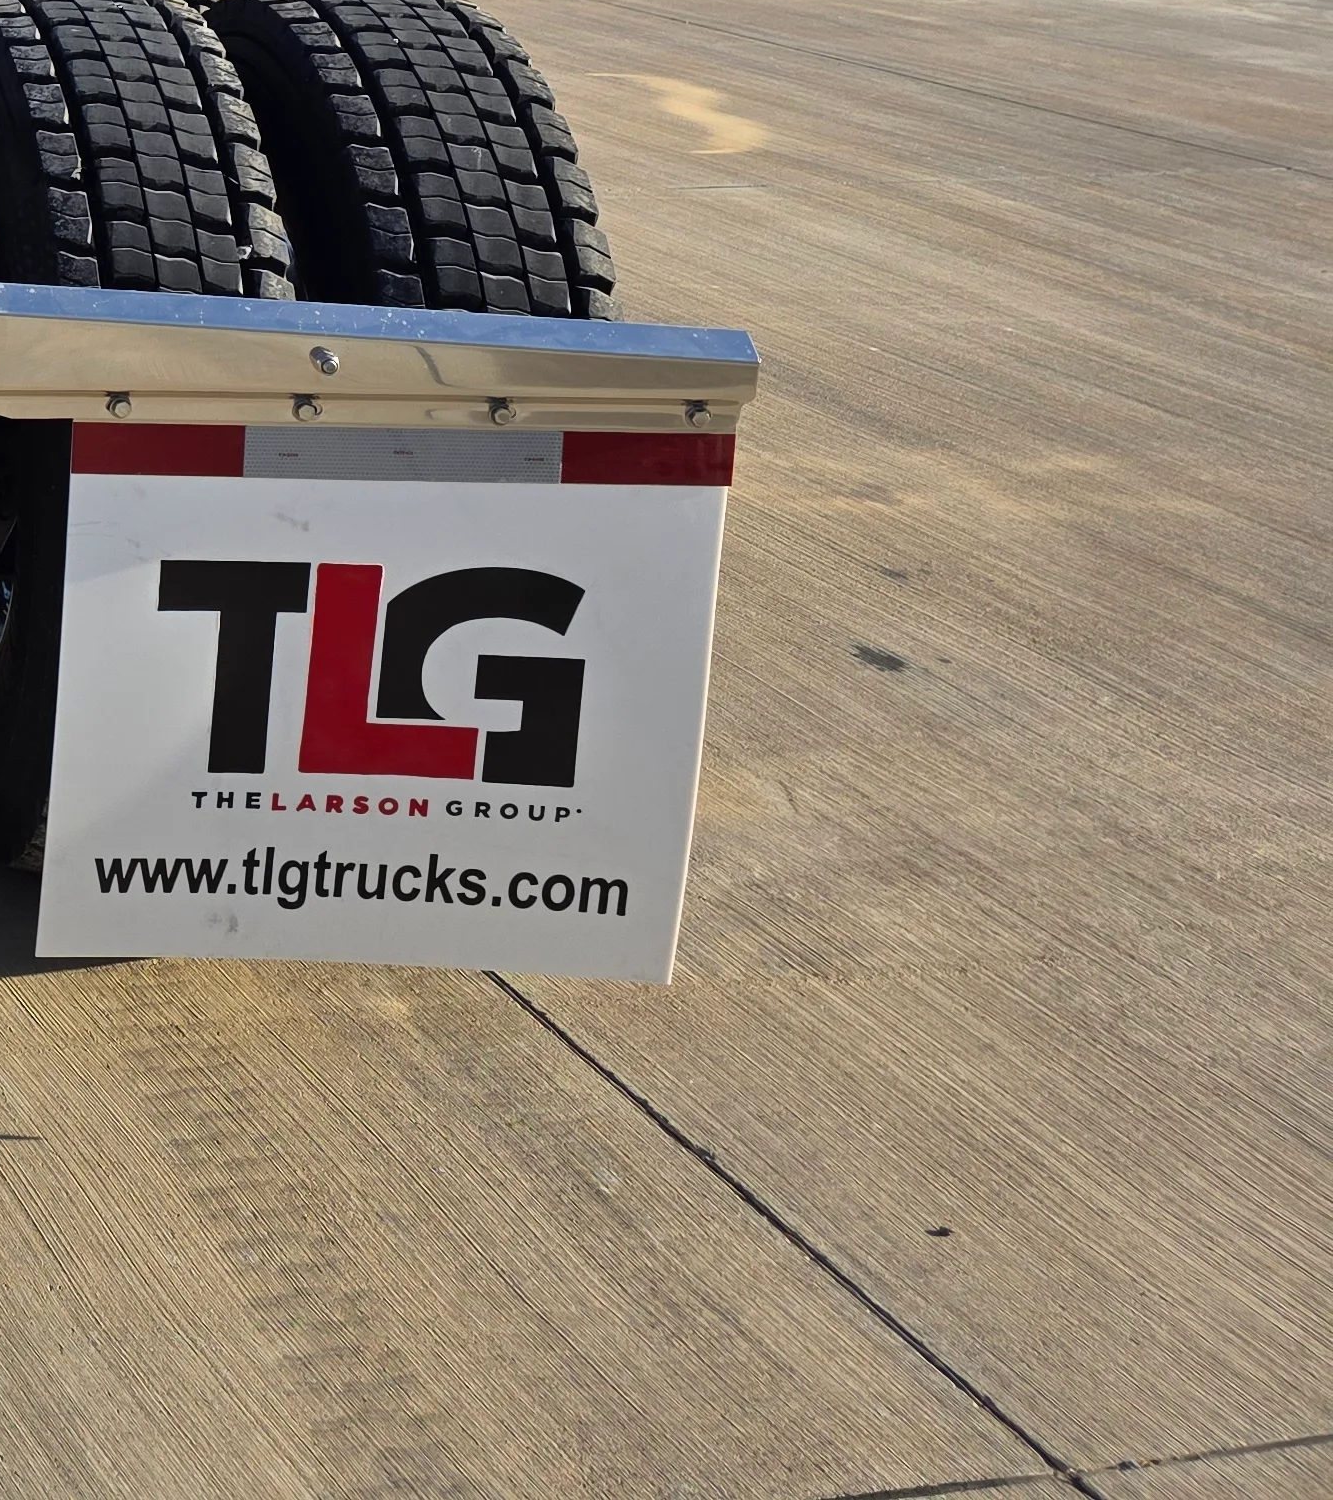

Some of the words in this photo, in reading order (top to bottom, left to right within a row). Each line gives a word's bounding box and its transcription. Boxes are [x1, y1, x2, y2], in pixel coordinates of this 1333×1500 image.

[157, 560, 586, 788] TLG
[445, 800, 571, 823] GROUP
[94, 847, 629, 917] www.tlgtrucks.com
